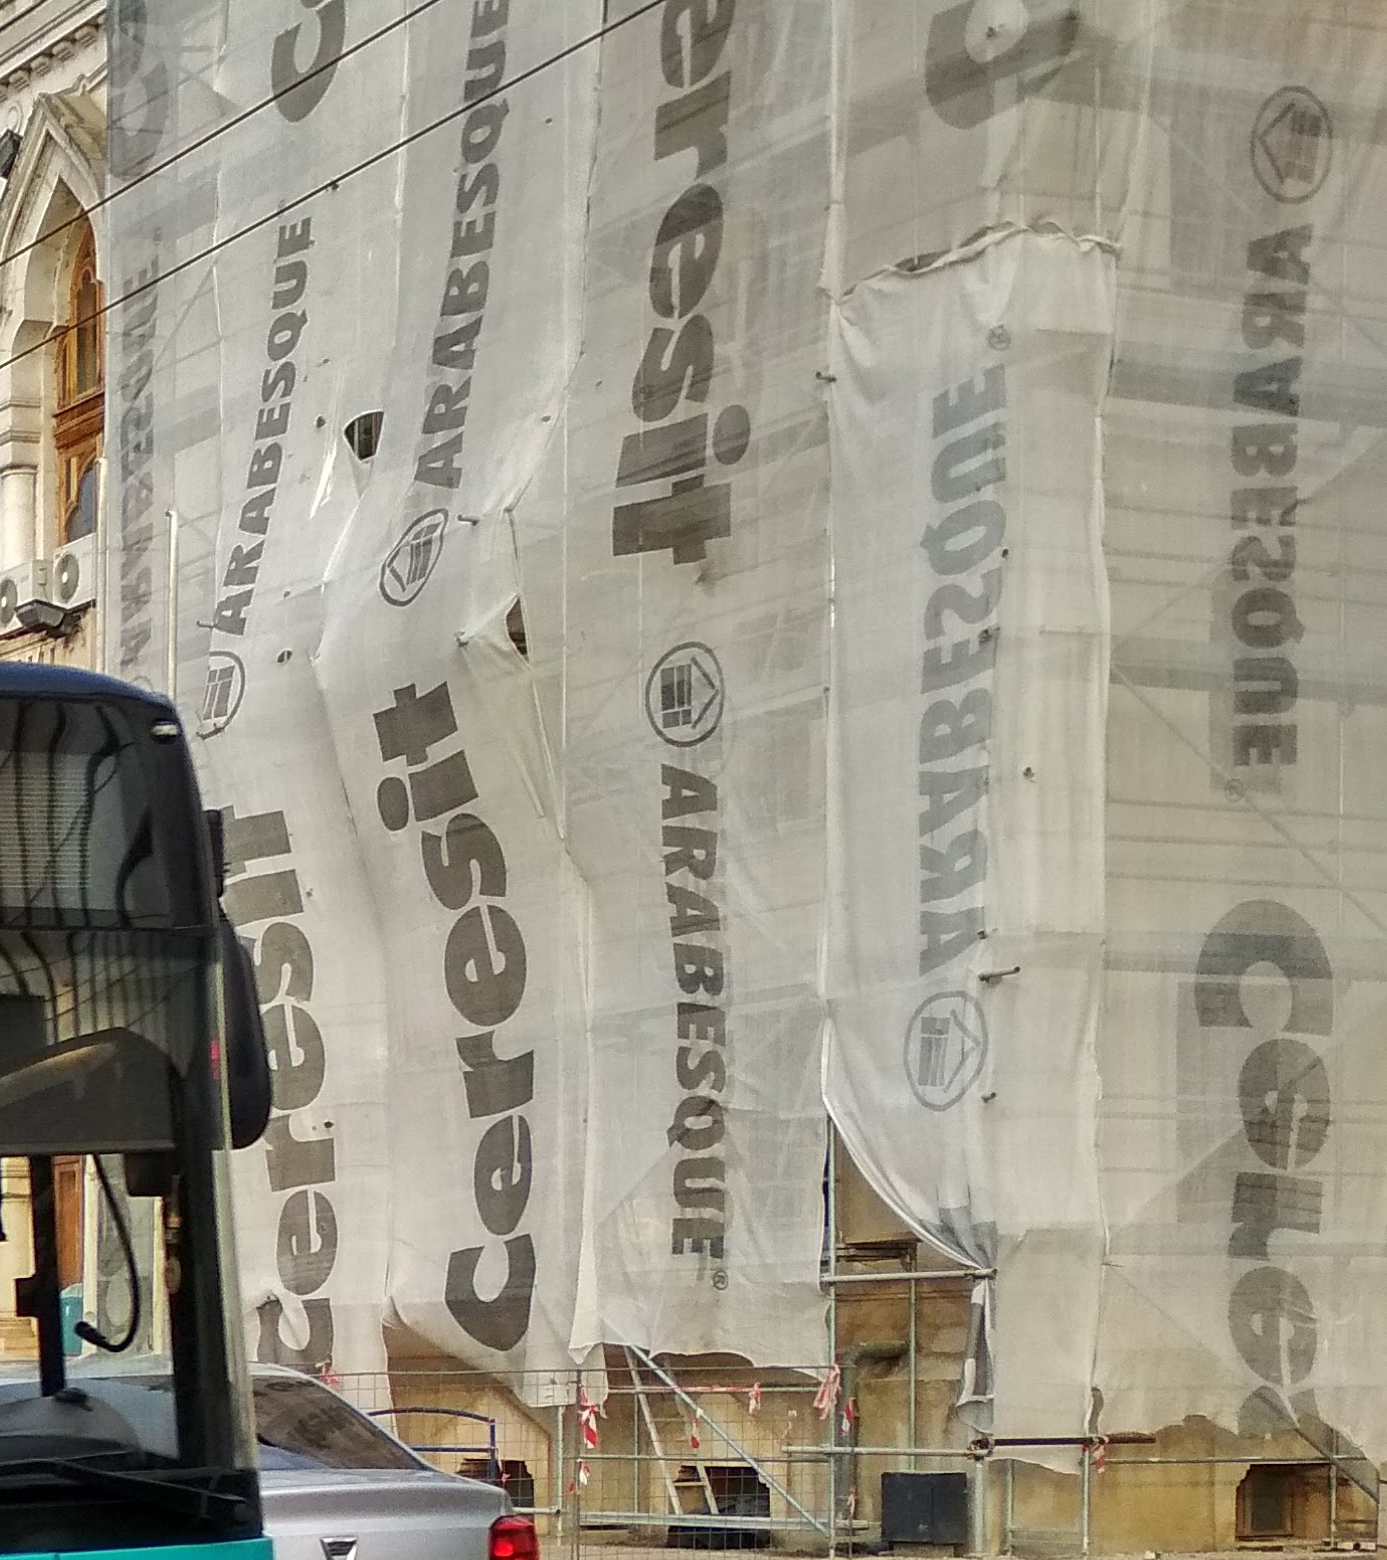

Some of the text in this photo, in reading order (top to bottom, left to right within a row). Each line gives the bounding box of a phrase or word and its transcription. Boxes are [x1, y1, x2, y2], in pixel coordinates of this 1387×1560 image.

[214, 217, 312, 636] ARABESQUE
[415, 0, 510, 490] ARABESQUE
[373, 682, 536, 1353] Ceresit
[660, 763, 728, 1260] ARABESQUE
